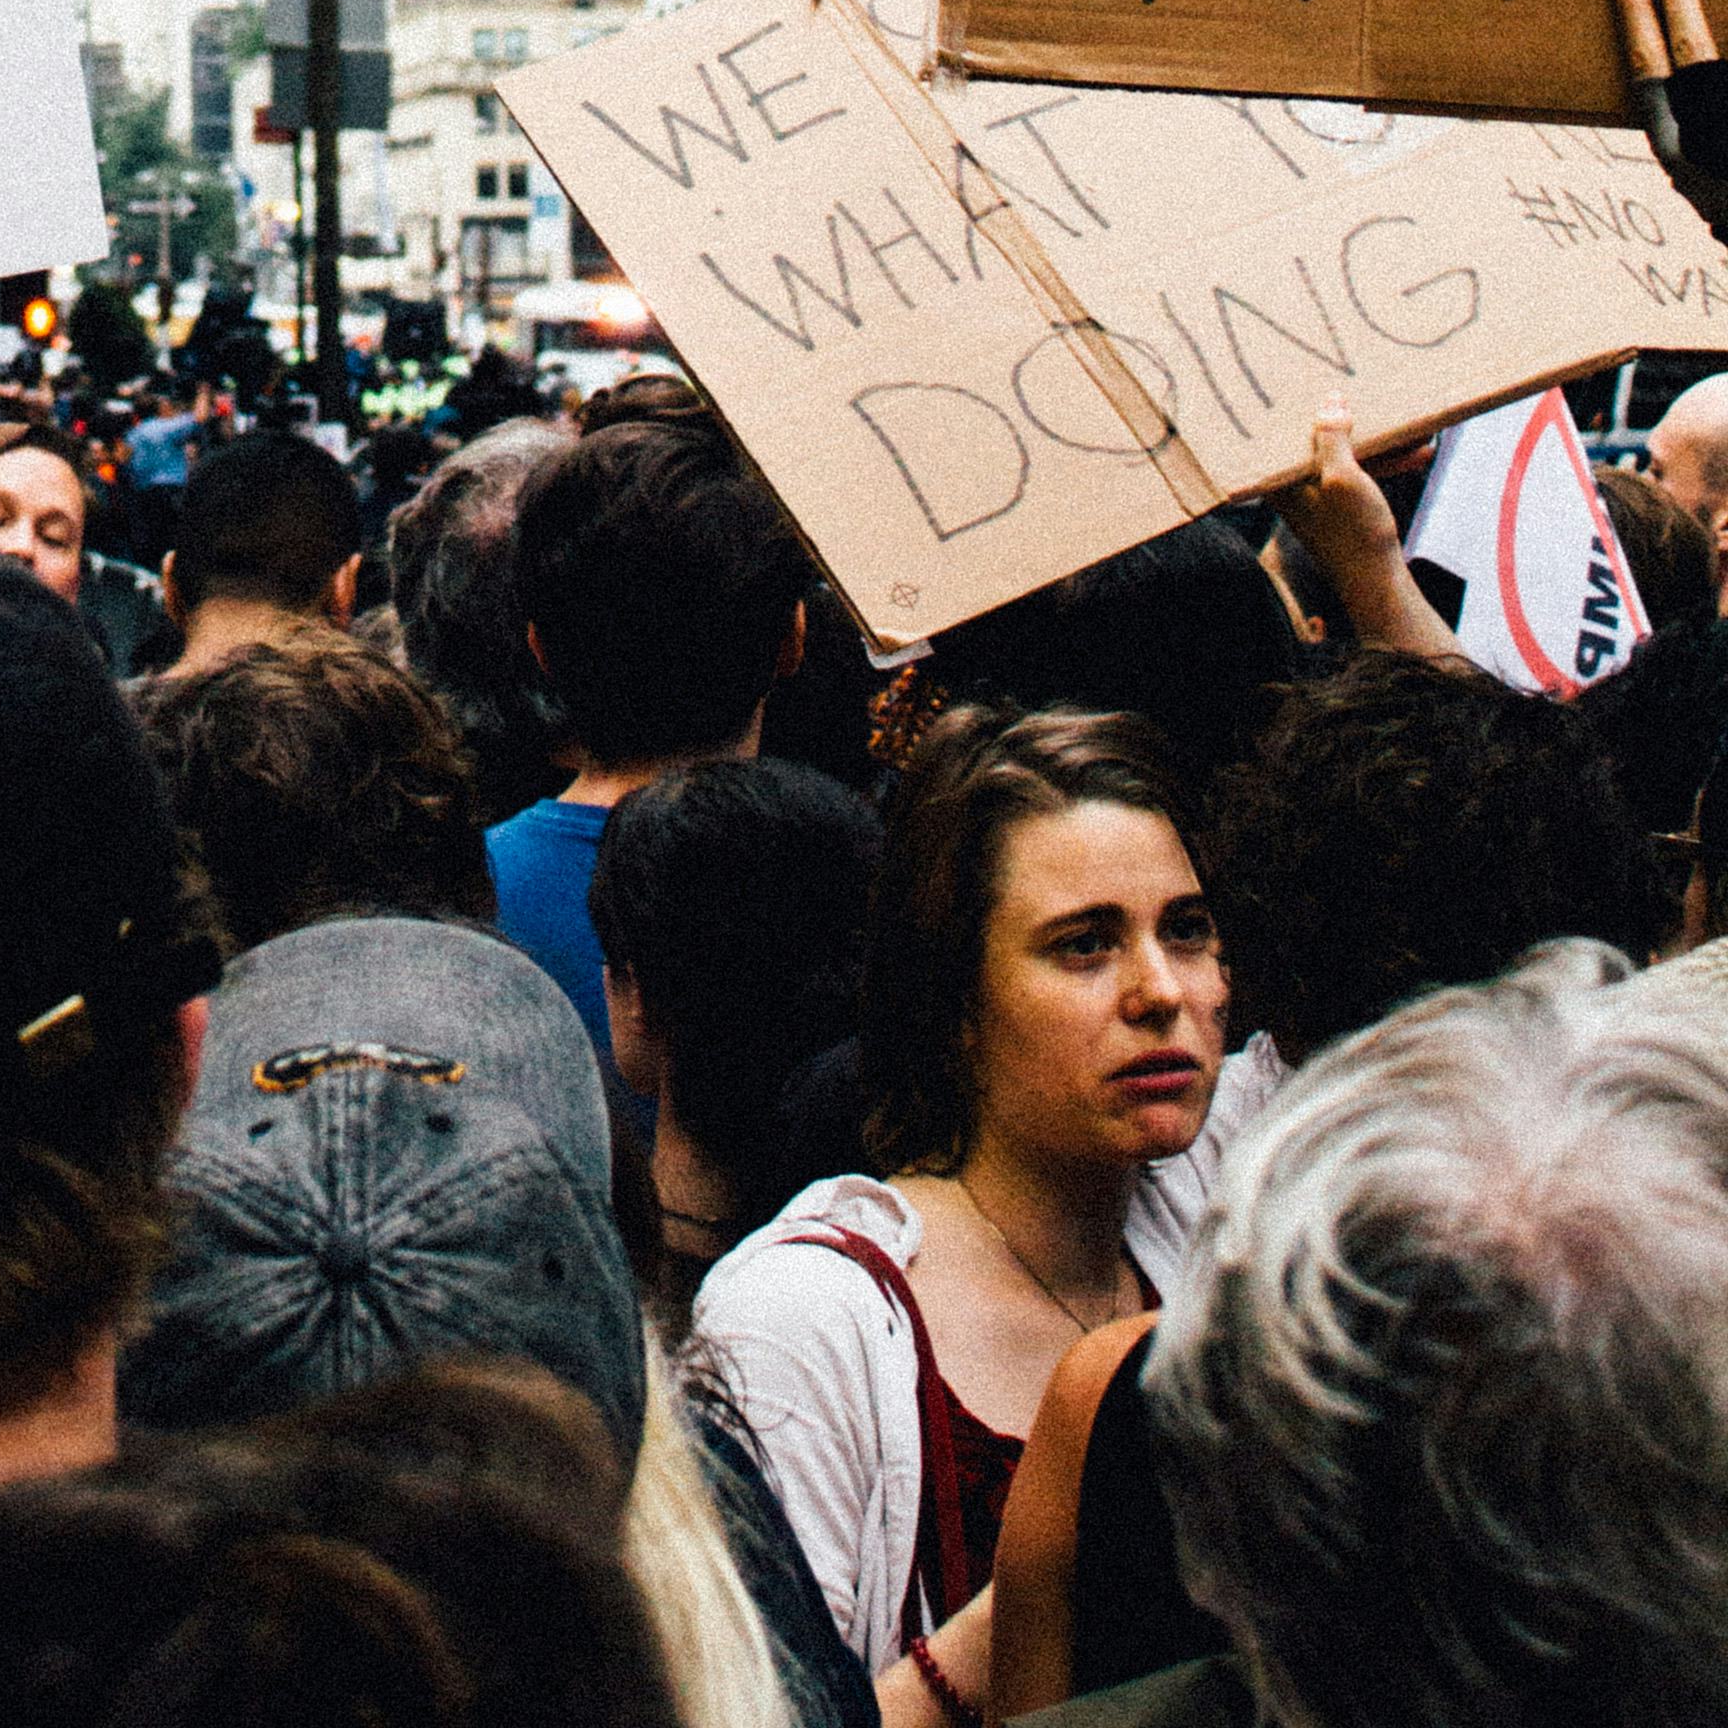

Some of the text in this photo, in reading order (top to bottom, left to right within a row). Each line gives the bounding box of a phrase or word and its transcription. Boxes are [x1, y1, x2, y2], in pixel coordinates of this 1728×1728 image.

[581, 20, 848, 191] WE
[1505, 176, 1666, 249] #NO
[699, 94, 1112, 352] WHAT
[849, 215, 1482, 543] DOING
